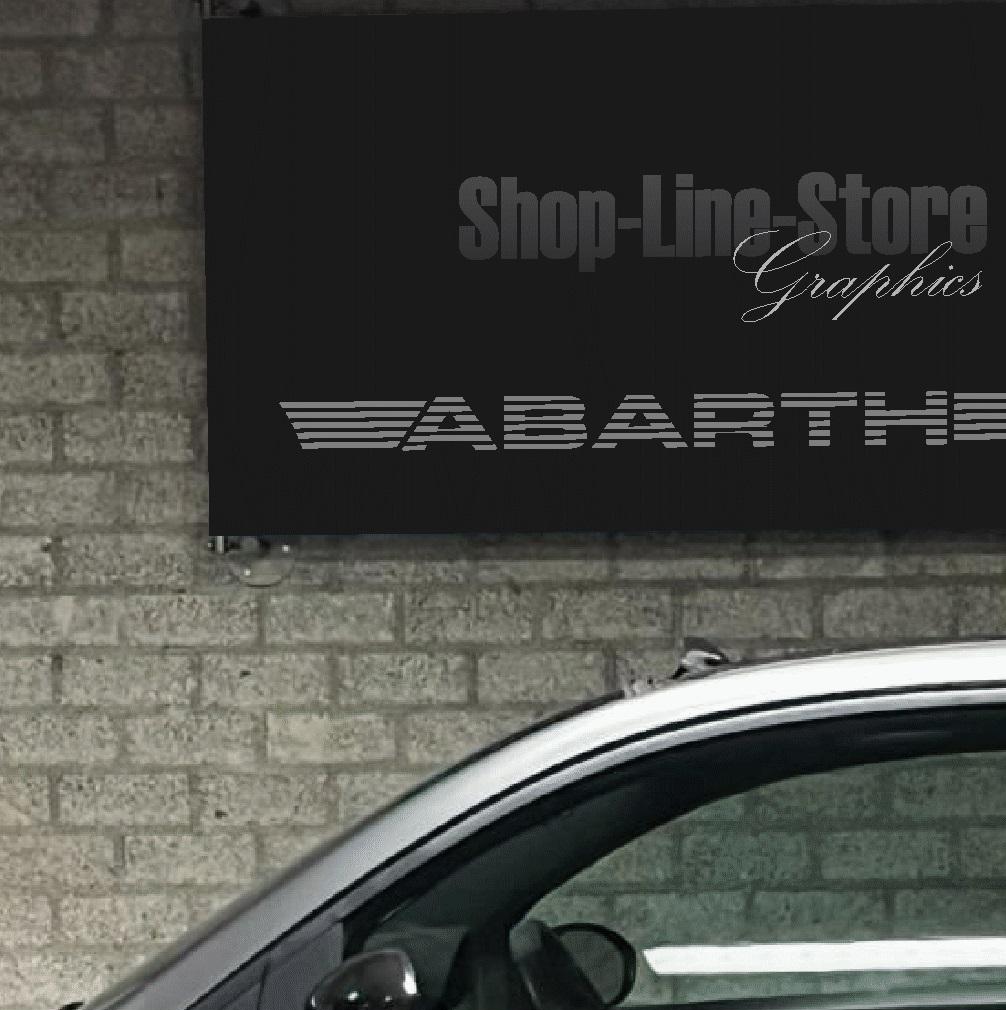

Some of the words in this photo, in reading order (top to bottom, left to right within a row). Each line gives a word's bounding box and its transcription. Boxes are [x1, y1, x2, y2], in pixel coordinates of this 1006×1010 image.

[458, 171, 988, 272] Shop-Line-Store
[732, 229, 983, 323] Graphics
[400, 390, 949, 452] ABARTH
